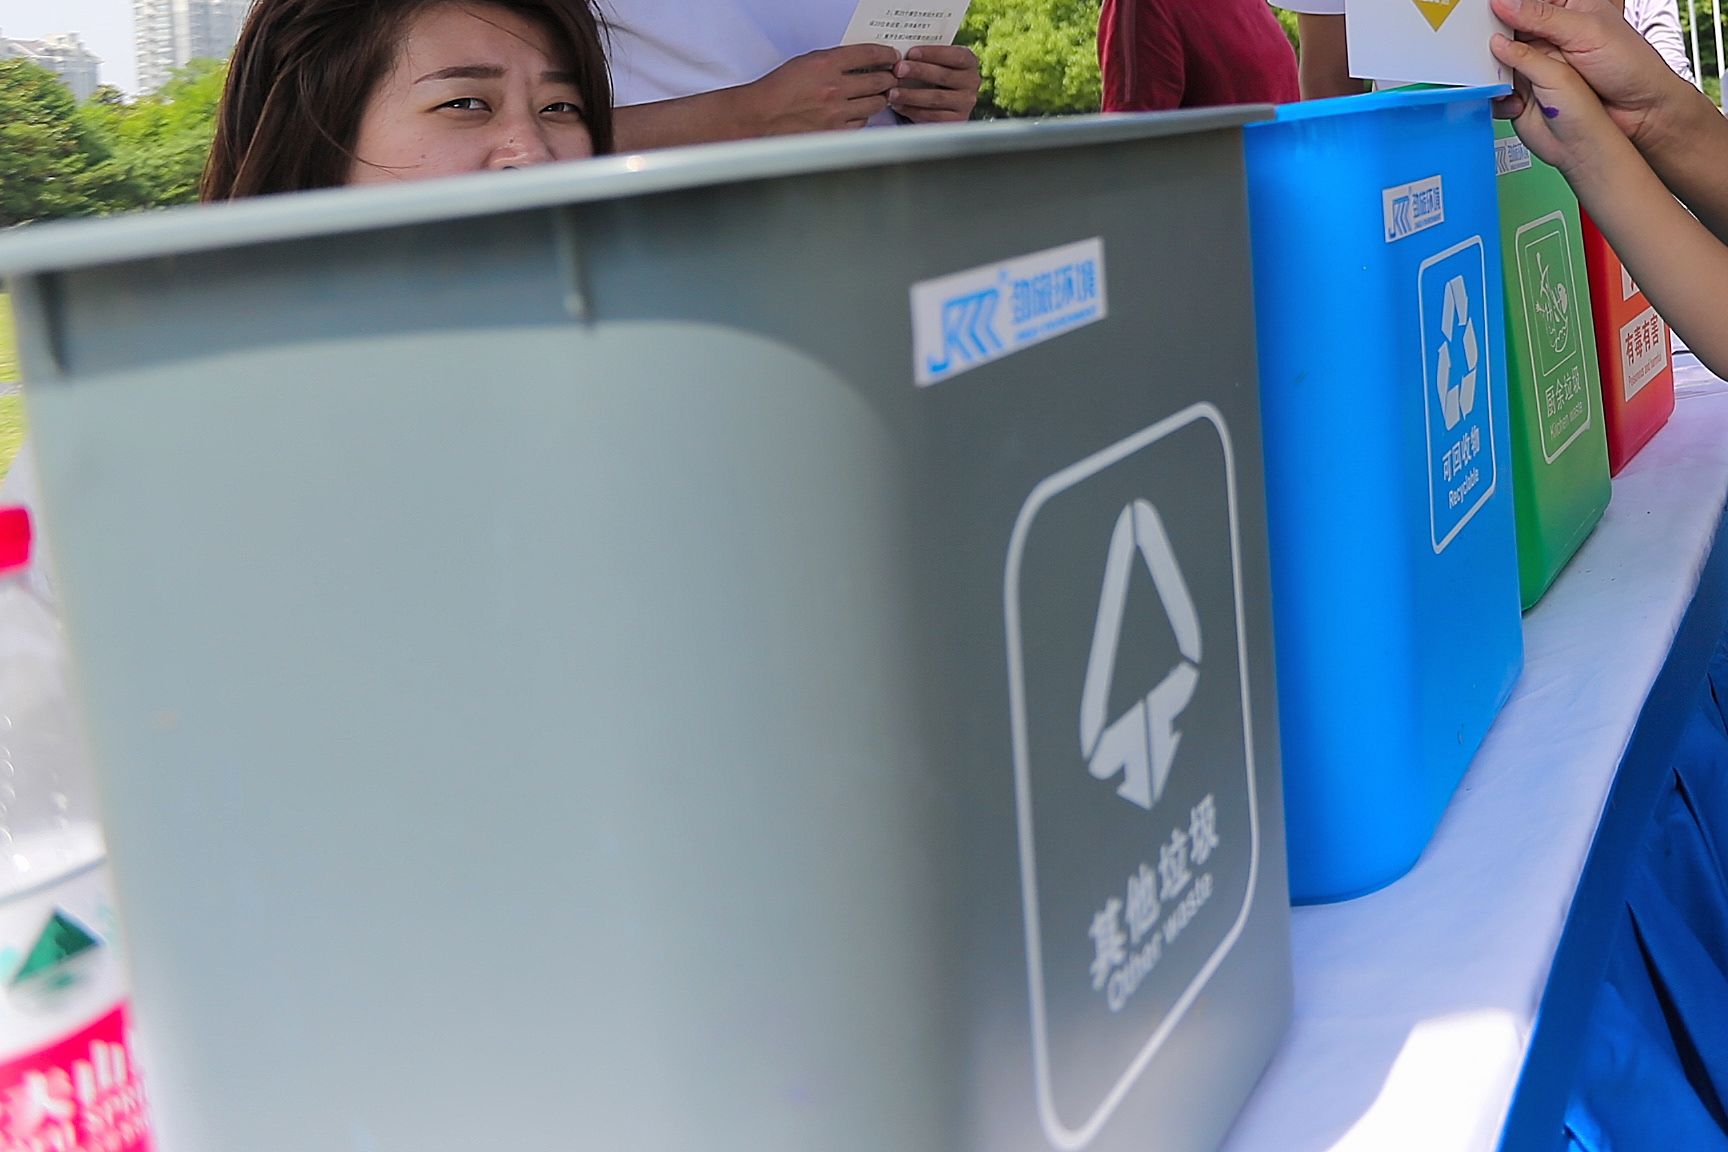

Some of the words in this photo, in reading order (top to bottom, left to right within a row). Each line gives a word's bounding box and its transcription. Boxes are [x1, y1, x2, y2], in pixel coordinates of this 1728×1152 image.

[1625, 313, 1659, 366] 有毒有害
[1545, 365, 1582, 418] 厨余垃圾
[1441, 425, 1481, 483] 可回收物
[1448, 467, 1480, 510] Recyclable
[1088, 792, 1220, 992] 其他垃圾
[1107, 932, 1163, 1014] Other
[1161, 871, 1214, 945] waste
